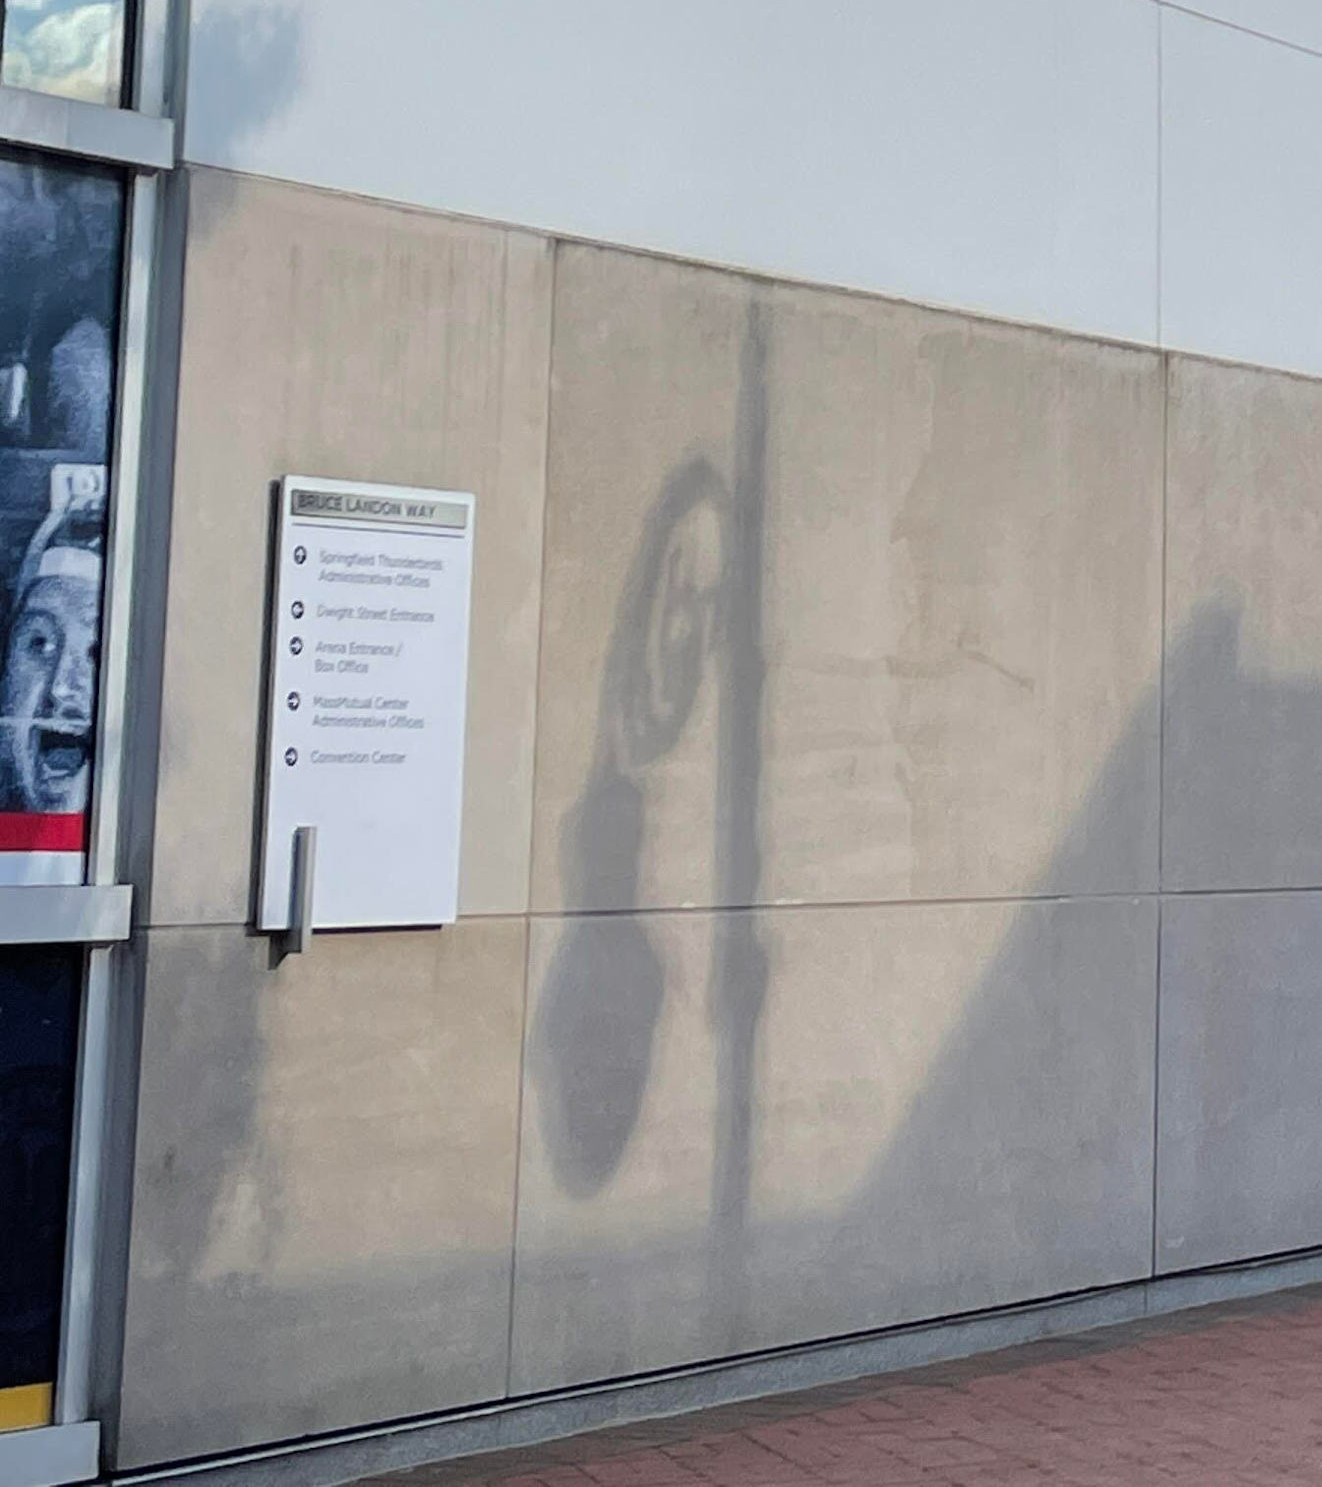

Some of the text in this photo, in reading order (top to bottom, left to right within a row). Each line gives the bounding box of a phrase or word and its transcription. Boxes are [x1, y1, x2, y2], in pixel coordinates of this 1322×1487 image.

[298, 494, 438, 519] BRUCE LANDON WAY
[319, 549, 444, 571] Springfield Thunderbirds
[318, 569, 430, 589] Administrative Offices
[316, 604, 435, 623] Dwight Street Entrance
[315, 641, 347, 654] Arena
[314, 658, 369, 674] Box Office
[313, 695, 409, 711] MassMutual Center
[312, 714, 425, 729] Administrative Offices
[310, 749, 407, 765] Convention Center
